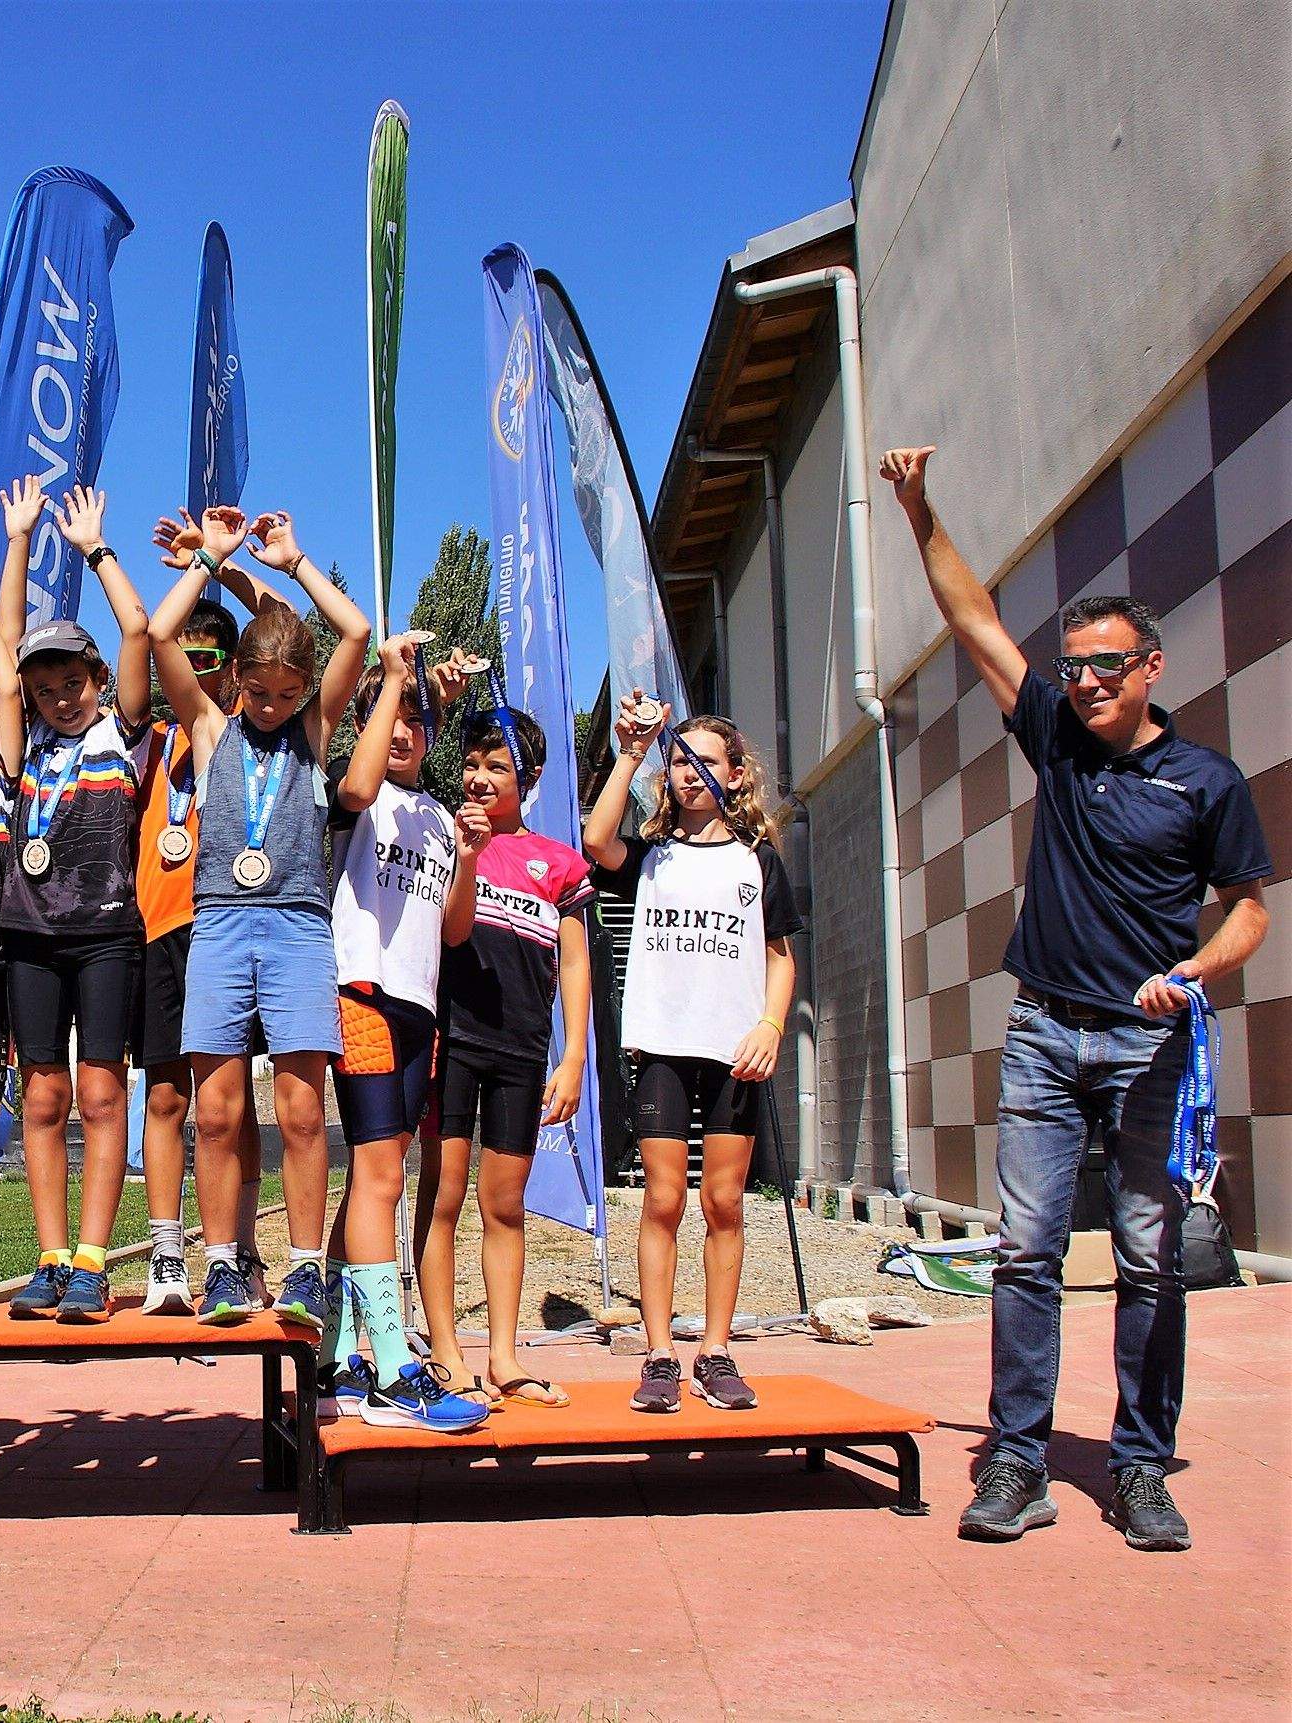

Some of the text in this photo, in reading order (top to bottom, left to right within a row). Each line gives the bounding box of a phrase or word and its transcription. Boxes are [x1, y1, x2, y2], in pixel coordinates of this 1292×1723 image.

[505, 724, 524, 772] SPAINSNOW
[686, 752, 716, 788] SPAINSNOW
[247, 775, 258, 823] SPAINSNOW
[254, 793, 275, 842] SPAINSNOW
[375, 841, 450, 888] RRINTZI
[645, 907, 746, 938] IRRINTZI
[646, 932, 740, 960] ski taldea
[1196, 1045, 1210, 1104] SPAINSNOW
